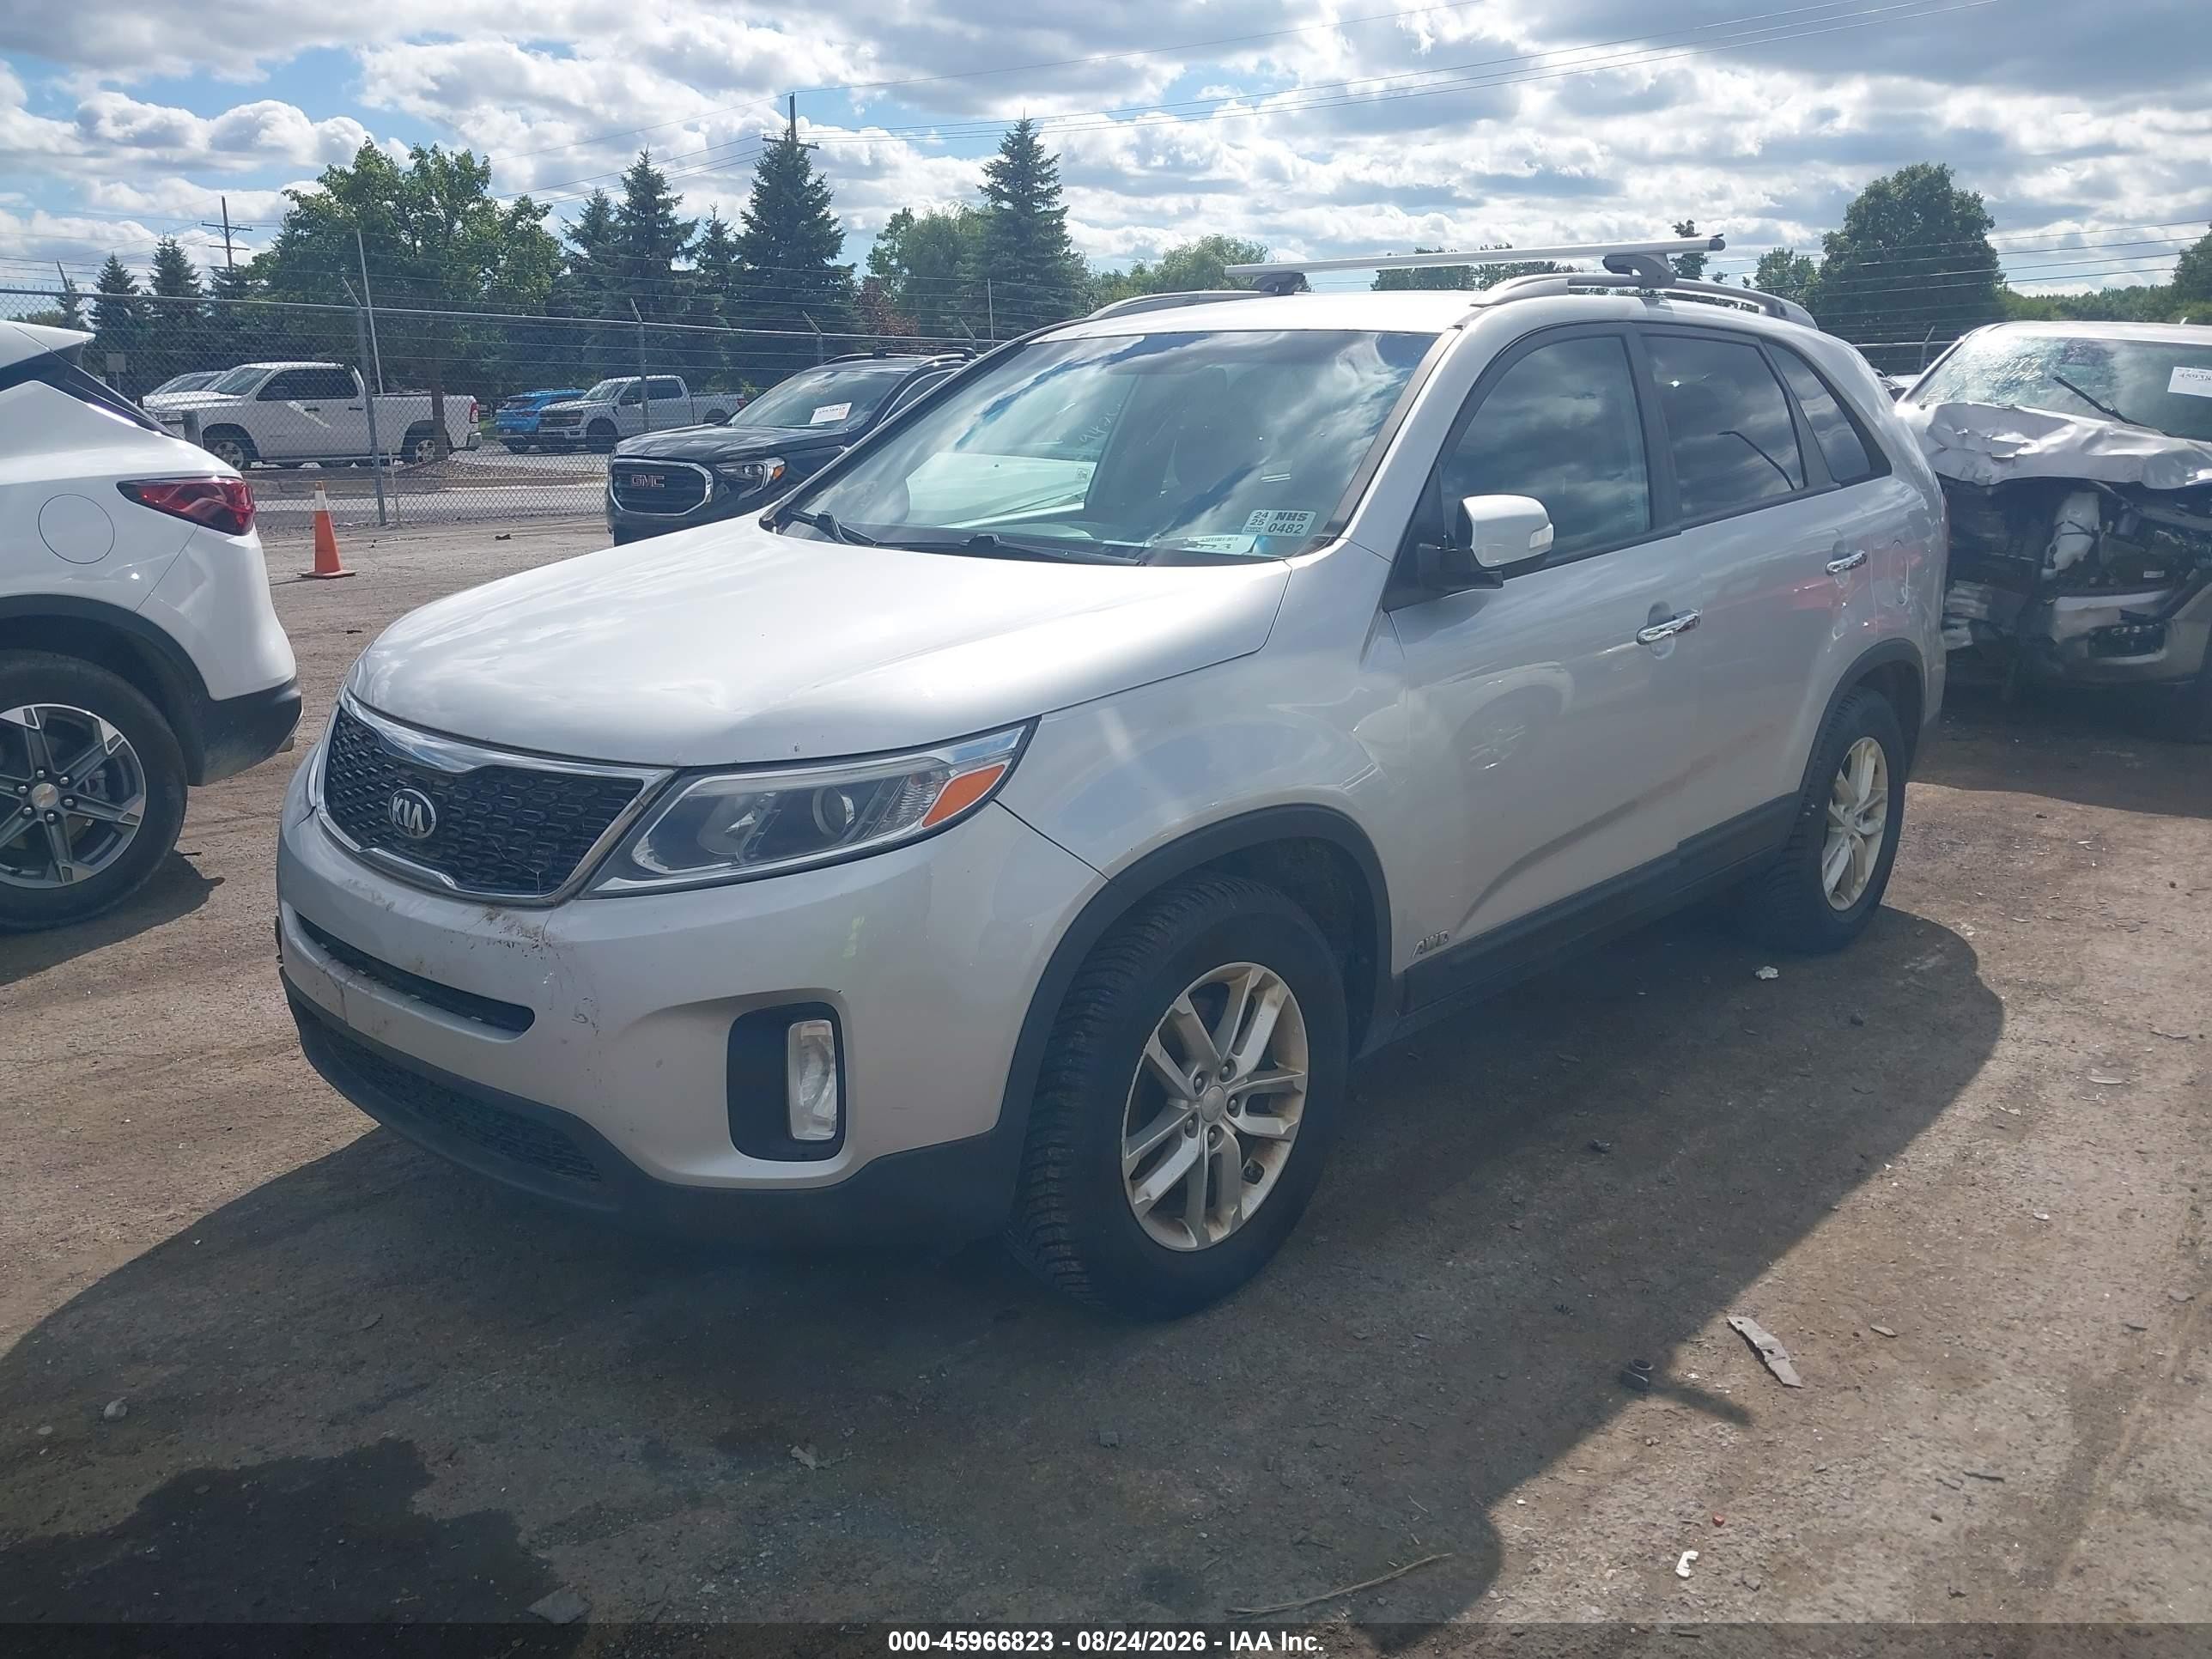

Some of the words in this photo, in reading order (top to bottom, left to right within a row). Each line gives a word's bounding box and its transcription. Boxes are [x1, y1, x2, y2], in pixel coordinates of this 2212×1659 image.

[631, 474, 665, 488] GMC
[1274, 512, 1309, 522] NHS
[1267, 523, 1304, 534] 0482
[392, 796, 425, 832] KIA
